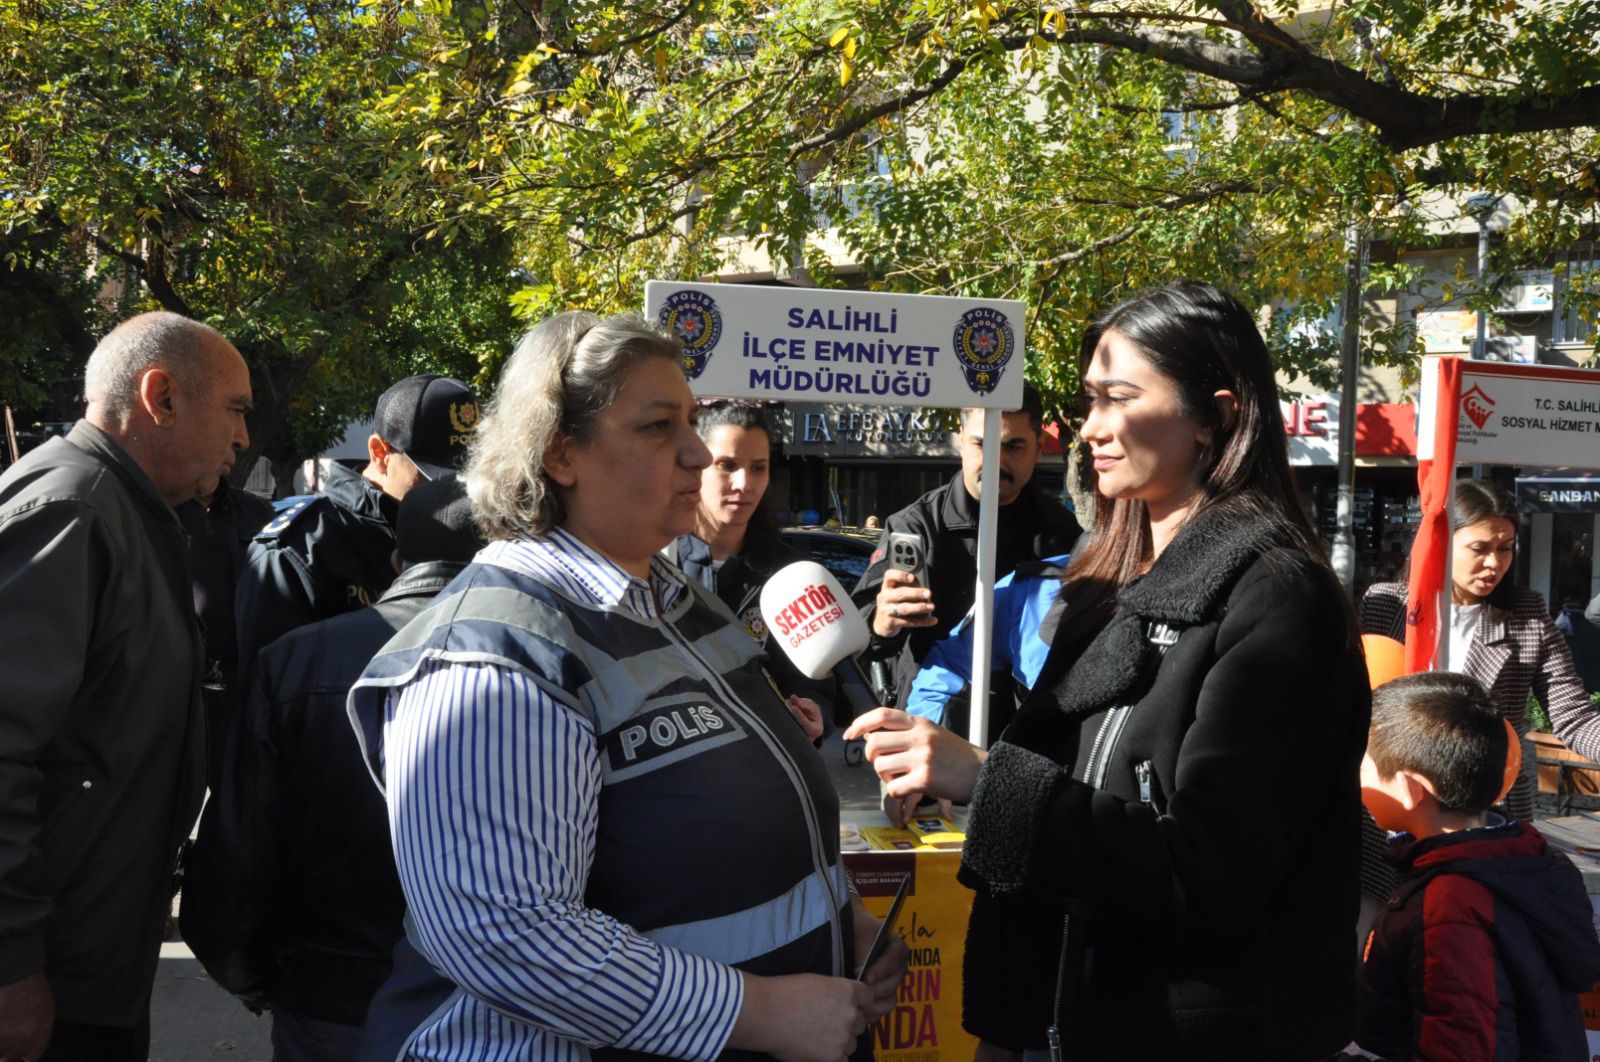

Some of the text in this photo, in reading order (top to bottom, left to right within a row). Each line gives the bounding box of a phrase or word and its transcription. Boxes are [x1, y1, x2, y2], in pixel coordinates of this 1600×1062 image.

[671, 291, 710, 306] POLİS
[787, 305, 897, 334] SALİHLİ
[966, 309, 1003, 322] POLİS
[743, 332, 806, 363] İLÇE
[814, 338, 940, 367] EMNİYET
[749, 364, 931, 397] MÜDÜRLÜĞÜ
[1534, 398, 1554, 410] T.C.
[836, 412, 874, 430] EFE
[1501, 416, 1547, 430] SOSYAL
[1549, 417, 1592, 432] HİZMET
[774, 584, 837, 636] SEKTÖR
[789, 603, 845, 649] GAZETESİ
[899, 969, 942, 1003] RIN
